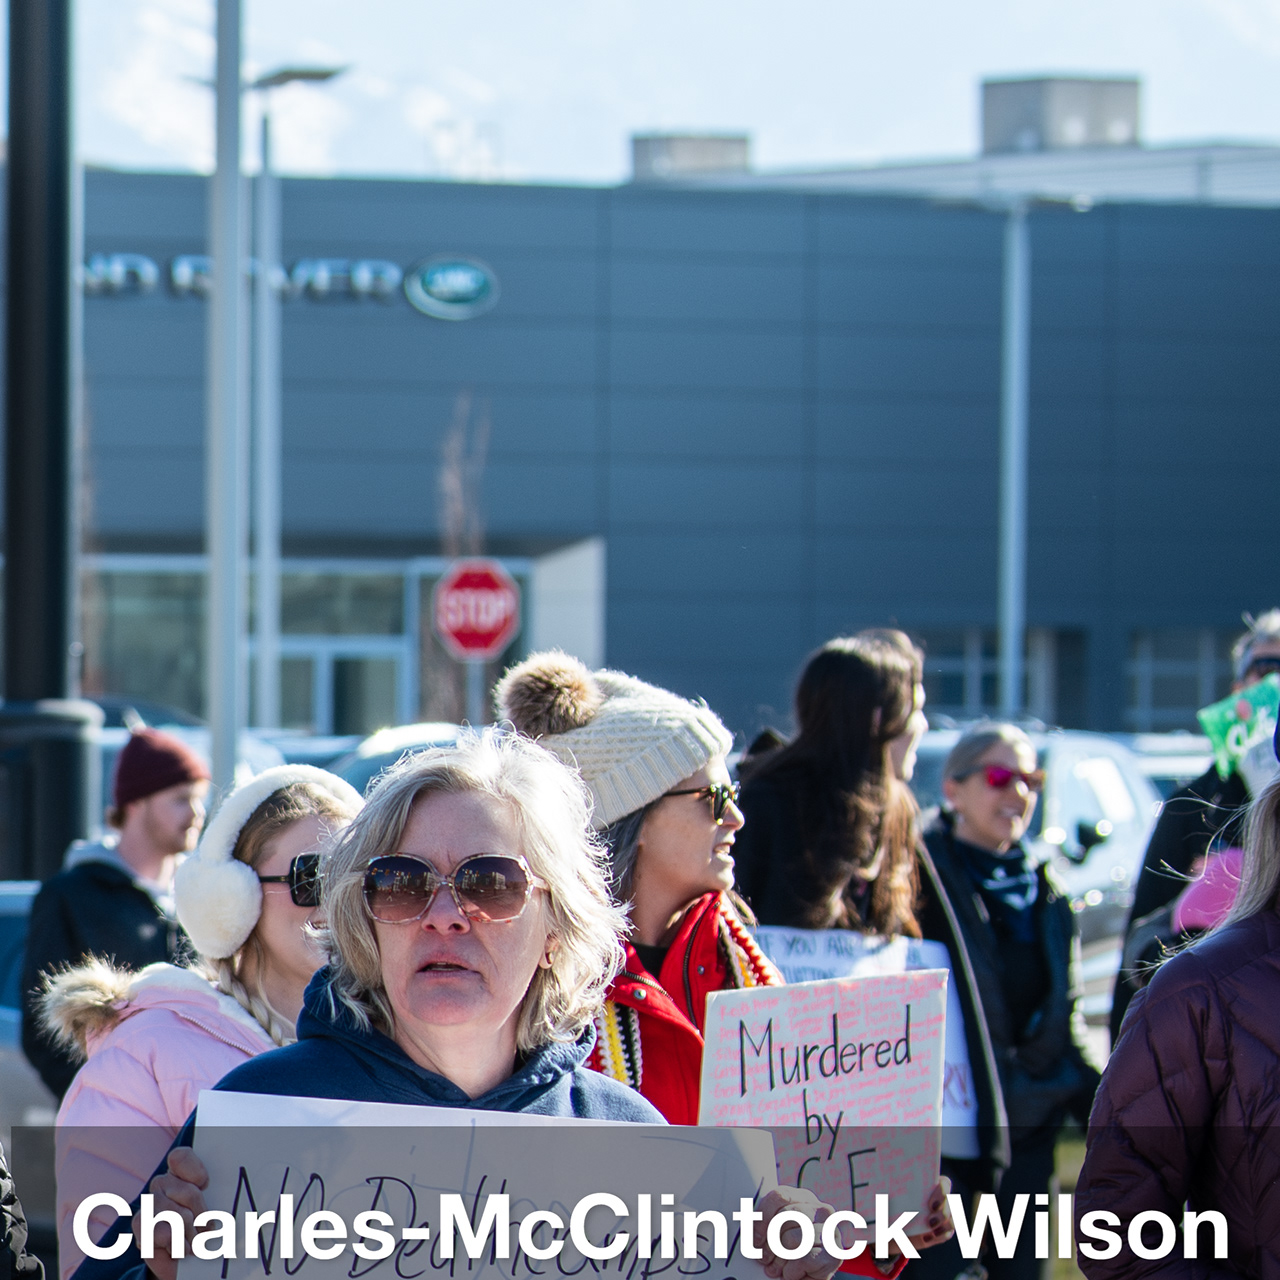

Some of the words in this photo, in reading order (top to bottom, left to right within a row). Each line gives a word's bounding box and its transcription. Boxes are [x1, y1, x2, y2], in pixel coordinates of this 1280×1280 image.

[438, 588, 514, 630] STOP
[739, 1003, 913, 1099] Murdered
[802, 1088, 845, 1161] by
